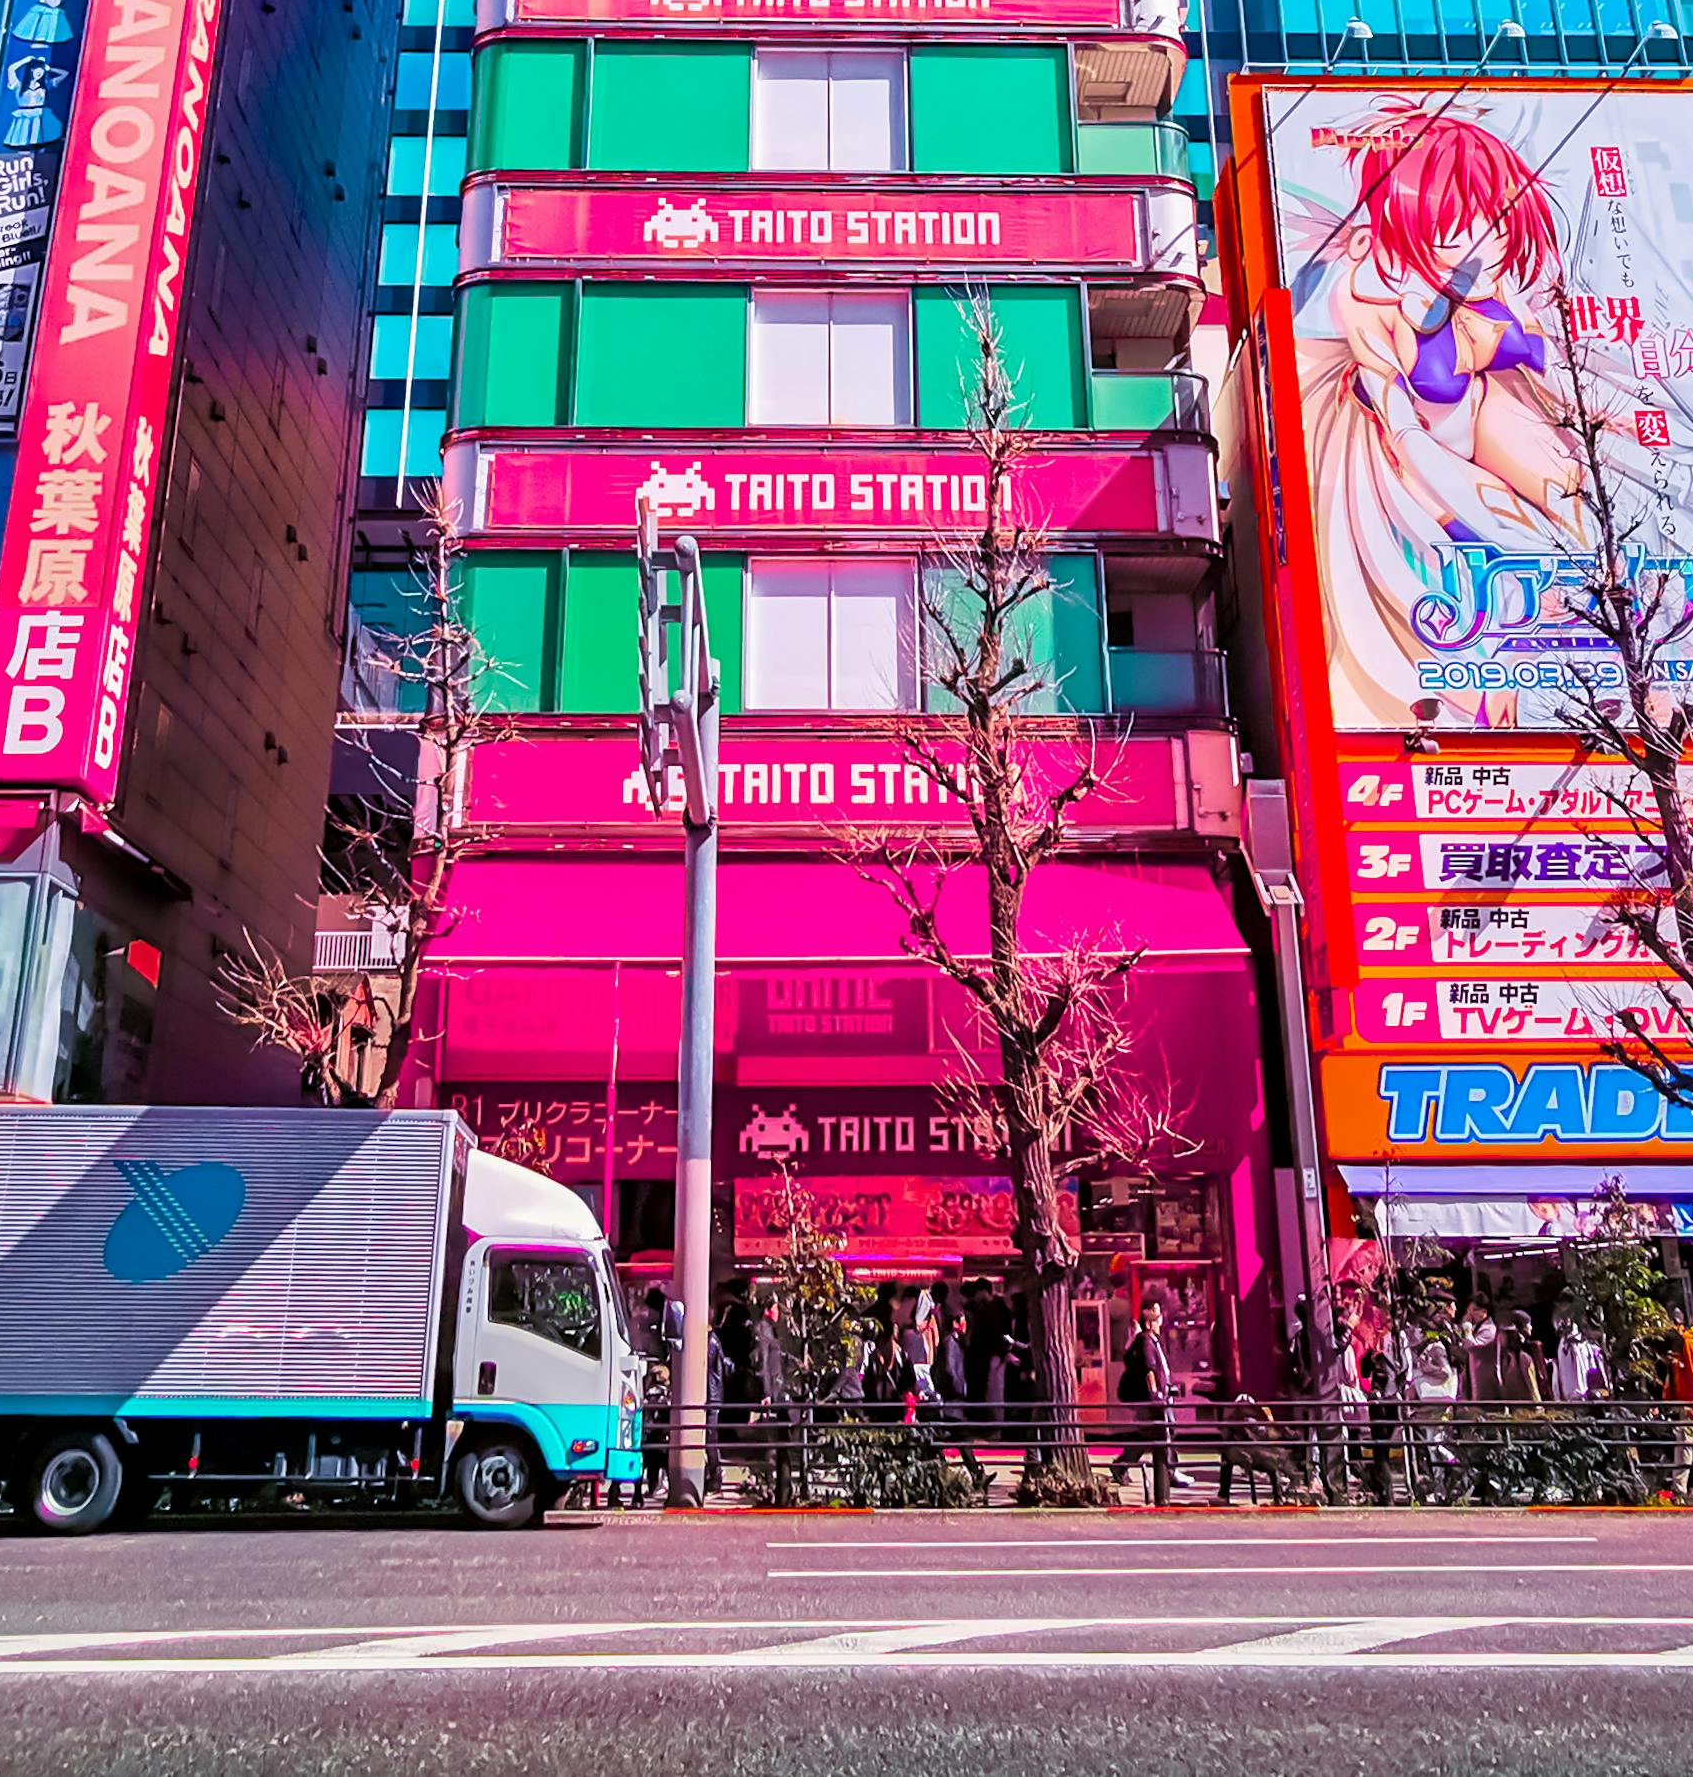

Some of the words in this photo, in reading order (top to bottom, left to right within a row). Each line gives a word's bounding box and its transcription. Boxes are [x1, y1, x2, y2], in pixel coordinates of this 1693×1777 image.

[727, 209, 834, 245] TAITO
[847, 210, 1001, 246] STATION
[1567, 295, 1646, 346] 世界
[724, 473, 835, 514] TAITO
[2, 400, 113, 756] 秋葉原店B
[718, 762, 835, 805] TAITO
[850, 763, 1021, 805] STATI
[1347, 775, 1404, 808] 4F
[1424, 766, 1464, 786] 新品
[1472, 766, 1512, 786] 中古
[1357, 844, 1412, 878] 3F
[1362, 917, 1420, 951] 2F
[1440, 908, 1481, 930] 新品
[1489, 908, 1529, 930] 中古
[1381, 993, 1427, 1027] 1F
[1449, 983, 1490, 1005] 新品
[1499, 983, 1540, 1005] 中古
[818, 1116, 915, 1153] TAITO
